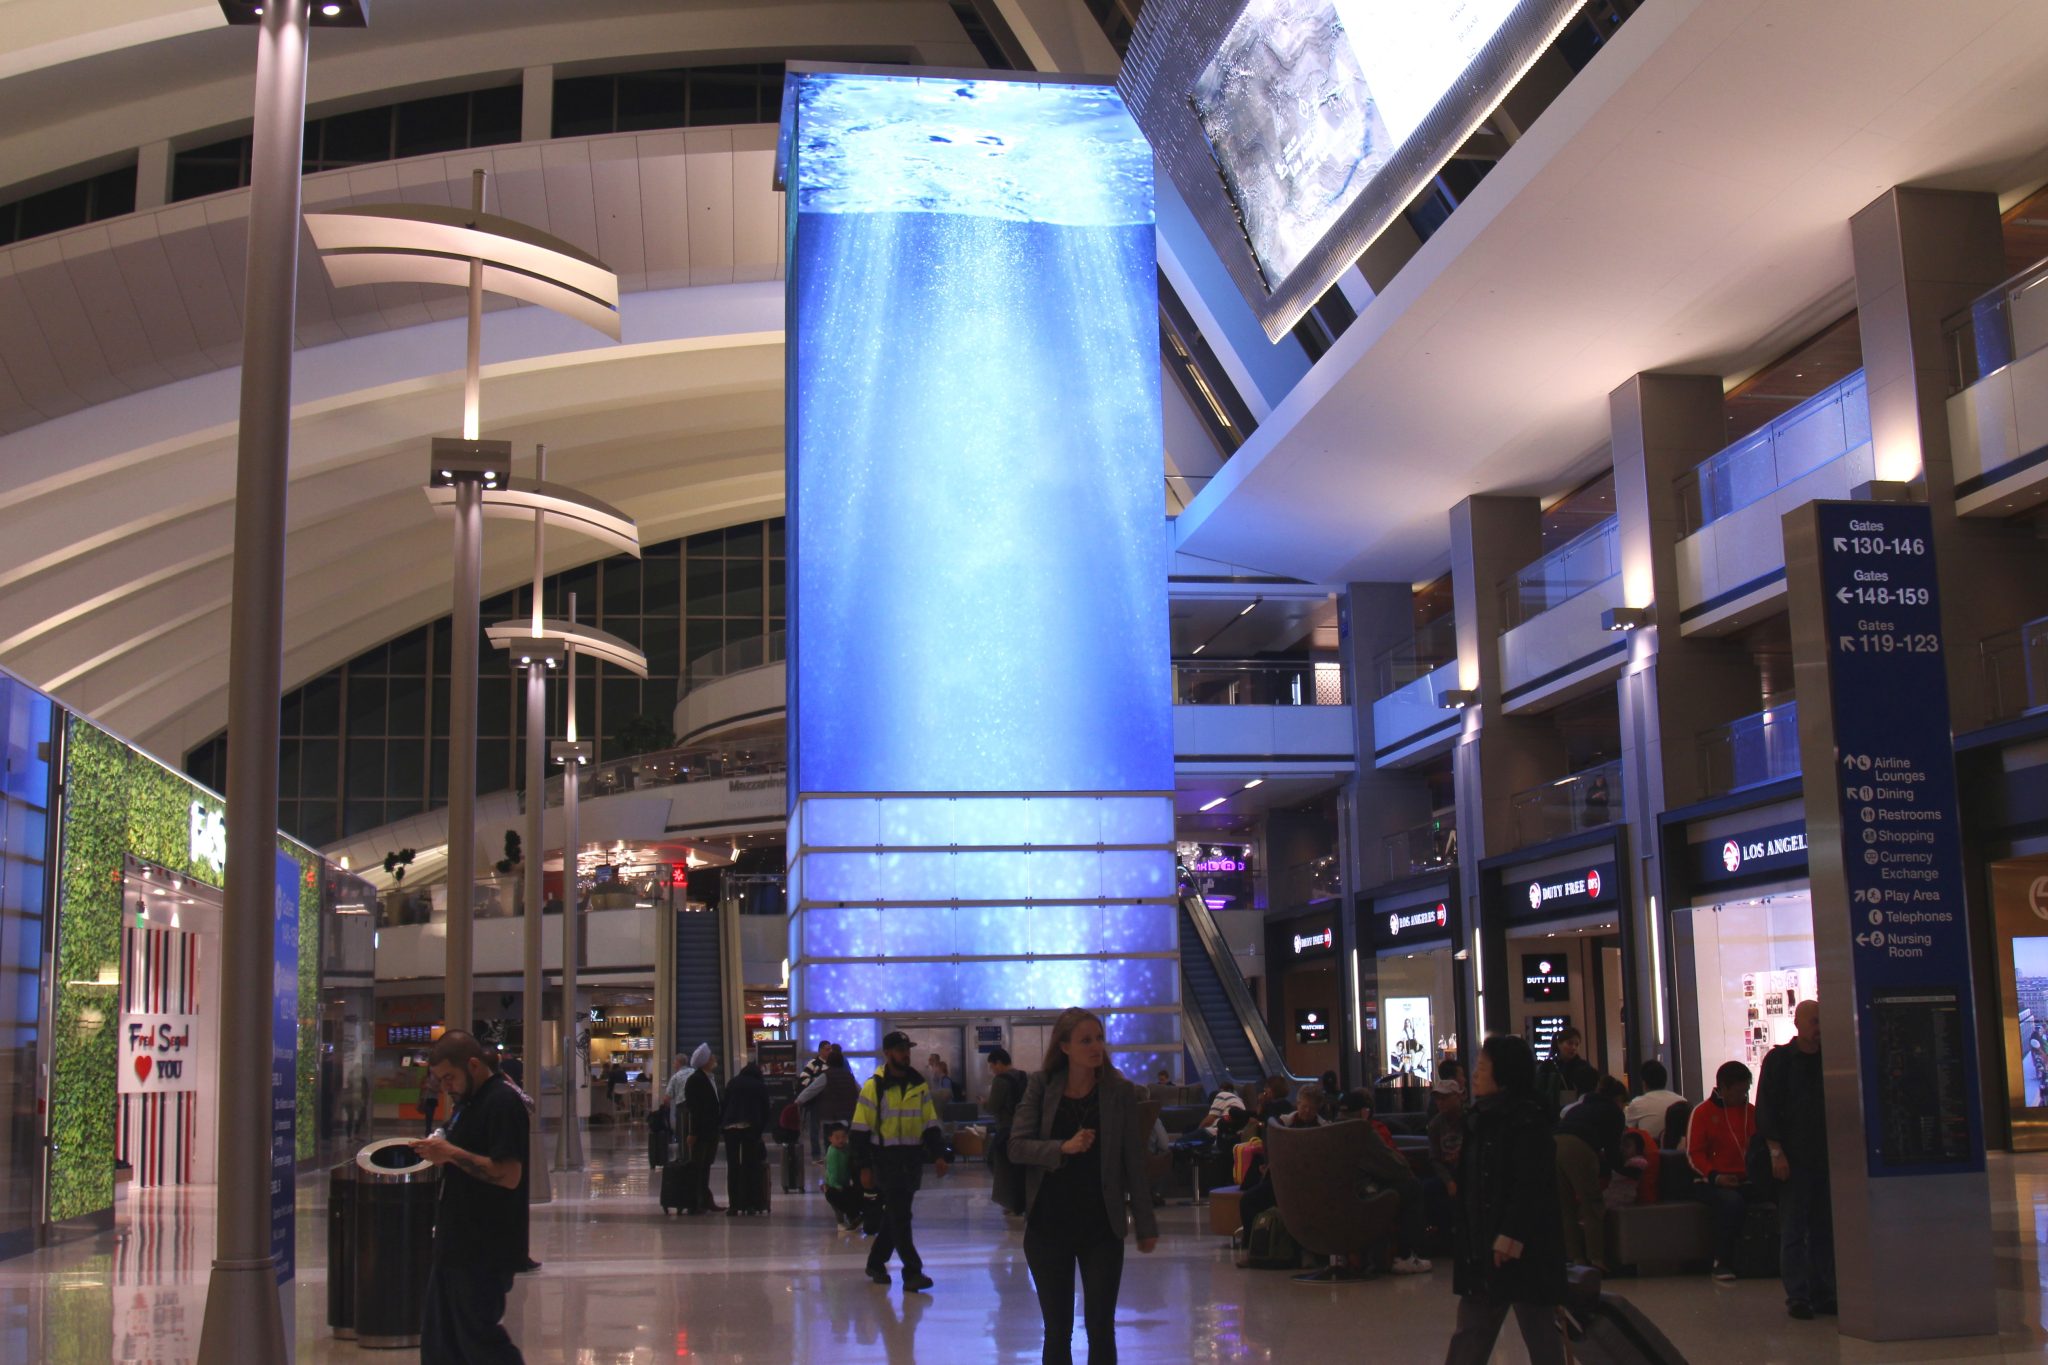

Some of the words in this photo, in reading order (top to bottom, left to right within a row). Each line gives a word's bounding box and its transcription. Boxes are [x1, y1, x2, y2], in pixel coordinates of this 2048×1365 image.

[1849, 519, 1885, 532] Gates
[1850, 537, 1925, 555] 130-146
[1853, 569, 1889, 582] Gates
[1855, 587, 1930, 605] 148-159
[1857, 619, 1895, 631] Gates
[1859, 634, 1939, 652] 119-123
[1874, 757, 1911, 768] Airline
[1875, 770, 1926, 784] Lounges
[1876, 787, 1914, 801] Dining
[1878, 808, 1942, 820] Restrooms
[1878, 830, 1934, 844] Shopping
[1743, 842, 1765, 861] LOS
[1880, 851, 1933, 865] Currency
[1881, 868, 1939, 881] Exchange
[1542, 884, 1563, 900] DUTY
[1564, 880, 1586, 896] FREE
[1884, 889, 1910, 904] Play
[1913, 889, 1941, 901] Area
[1886, 911, 1953, 924] Telephones
[1887, 932, 1932, 946] Nursing
[1889, 946, 1923, 957] Room
[1526, 976, 1546, 984] DUTY
[156, 1060, 183, 1079] YOU
